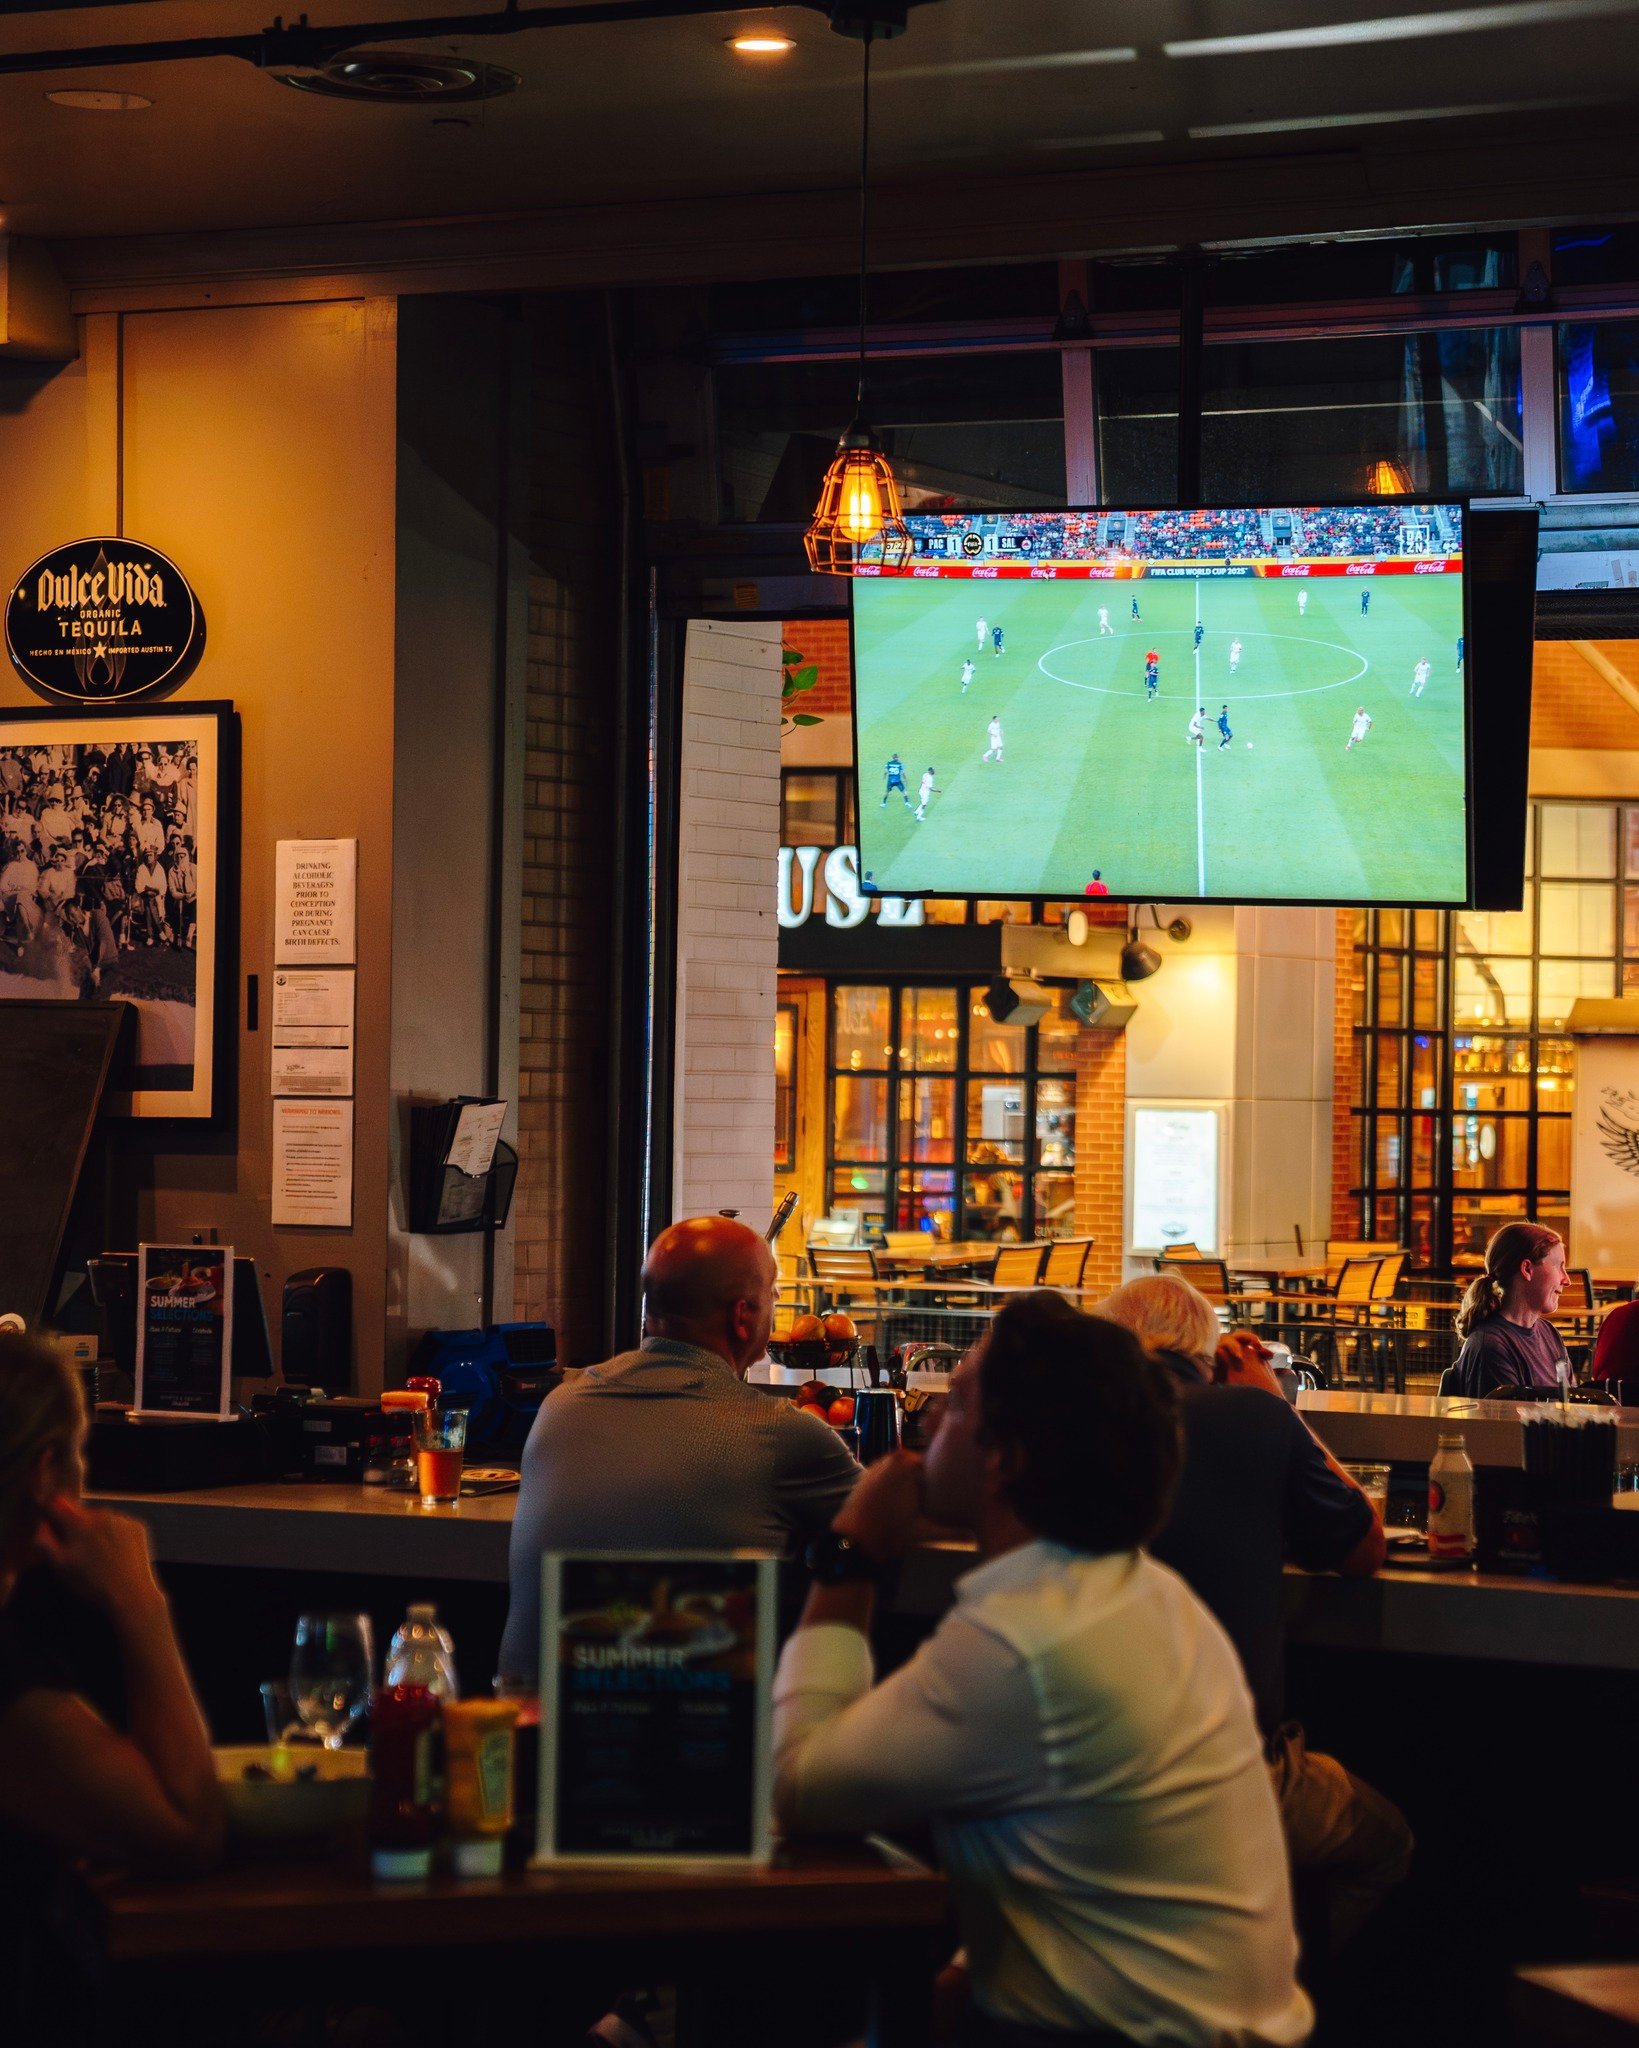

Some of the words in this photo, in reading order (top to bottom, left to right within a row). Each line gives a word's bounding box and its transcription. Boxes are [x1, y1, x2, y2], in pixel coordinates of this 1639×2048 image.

[928, 538, 944, 549] PAC
[1001, 538, 1016, 549] SAL
[1150, 568, 1166, 576] FIFA
[1166, 568, 1184, 576] CLUB
[1185, 568, 1211, 576] WORLD
[1212, 567, 1227, 575] CUP
[1281, 565, 1310, 577] Coca-Cola
[1346, 563, 1376, 575] Coca-Cola
[1414, 561, 1446, 574] Coca-Cola
[37, 563, 106, 612] Dulce
[80, 608, 121, 619] ORGANIC
[58, 619, 142, 639] TEQUILA
[29, 649, 52, 658] HECHO
[54, 649, 64, 657] EN
[107, 646, 140, 656] IMPORTED
[140, 646, 163, 655] AUSTIN
[164, 645, 173, 653] TX
[296, 862, 331, 871] DRINKING
[293, 871, 334, 880] ALCOHOLIC
[292, 881, 334, 890] BEVERAGES
[296, 891, 318, 899] PRIOR
[319, 891, 329, 899] TO
[290, 900, 336, 909] CONCEPTION
[293, 909, 304, 918] OR
[305, 909, 333, 918] DURING
[291, 919, 333, 928] PREGNANCY
[292, 929, 307, 937] CAN
[308, 929, 331, 937] CAUSE
[284, 938, 307, 947] BIRTH
[150, 1295, 197, 1309] SUMMER
[573, 1644, 685, 1669] SUMMER
